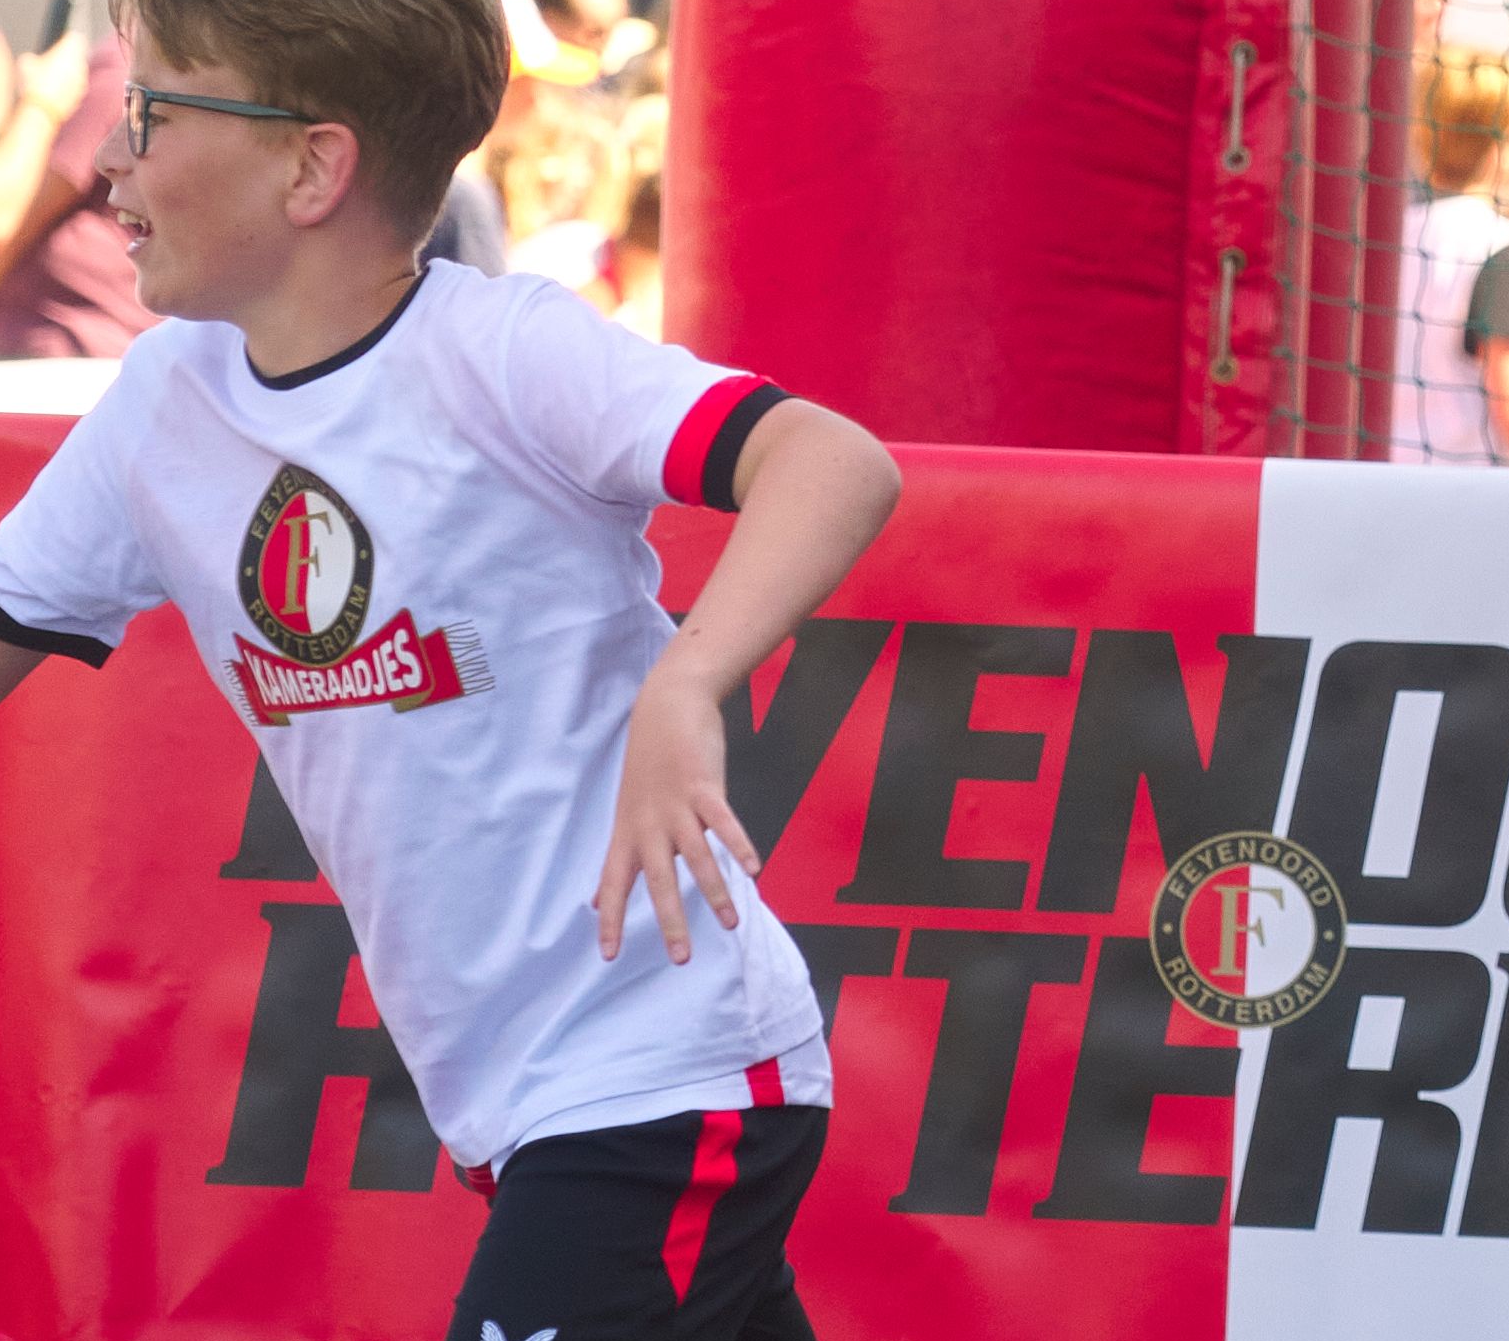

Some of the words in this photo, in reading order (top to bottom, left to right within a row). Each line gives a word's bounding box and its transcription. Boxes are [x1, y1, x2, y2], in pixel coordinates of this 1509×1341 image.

[279, 510, 332, 616] F
[250, 583, 368, 660] ROTTERDAM
[243, 628, 423, 706] KAMERAADJES
[1167, 838, 1335, 908] FEYENOORD
[1211, 885, 1285, 976] F
[1165, 955, 1330, 1024] ROTTERDAM
